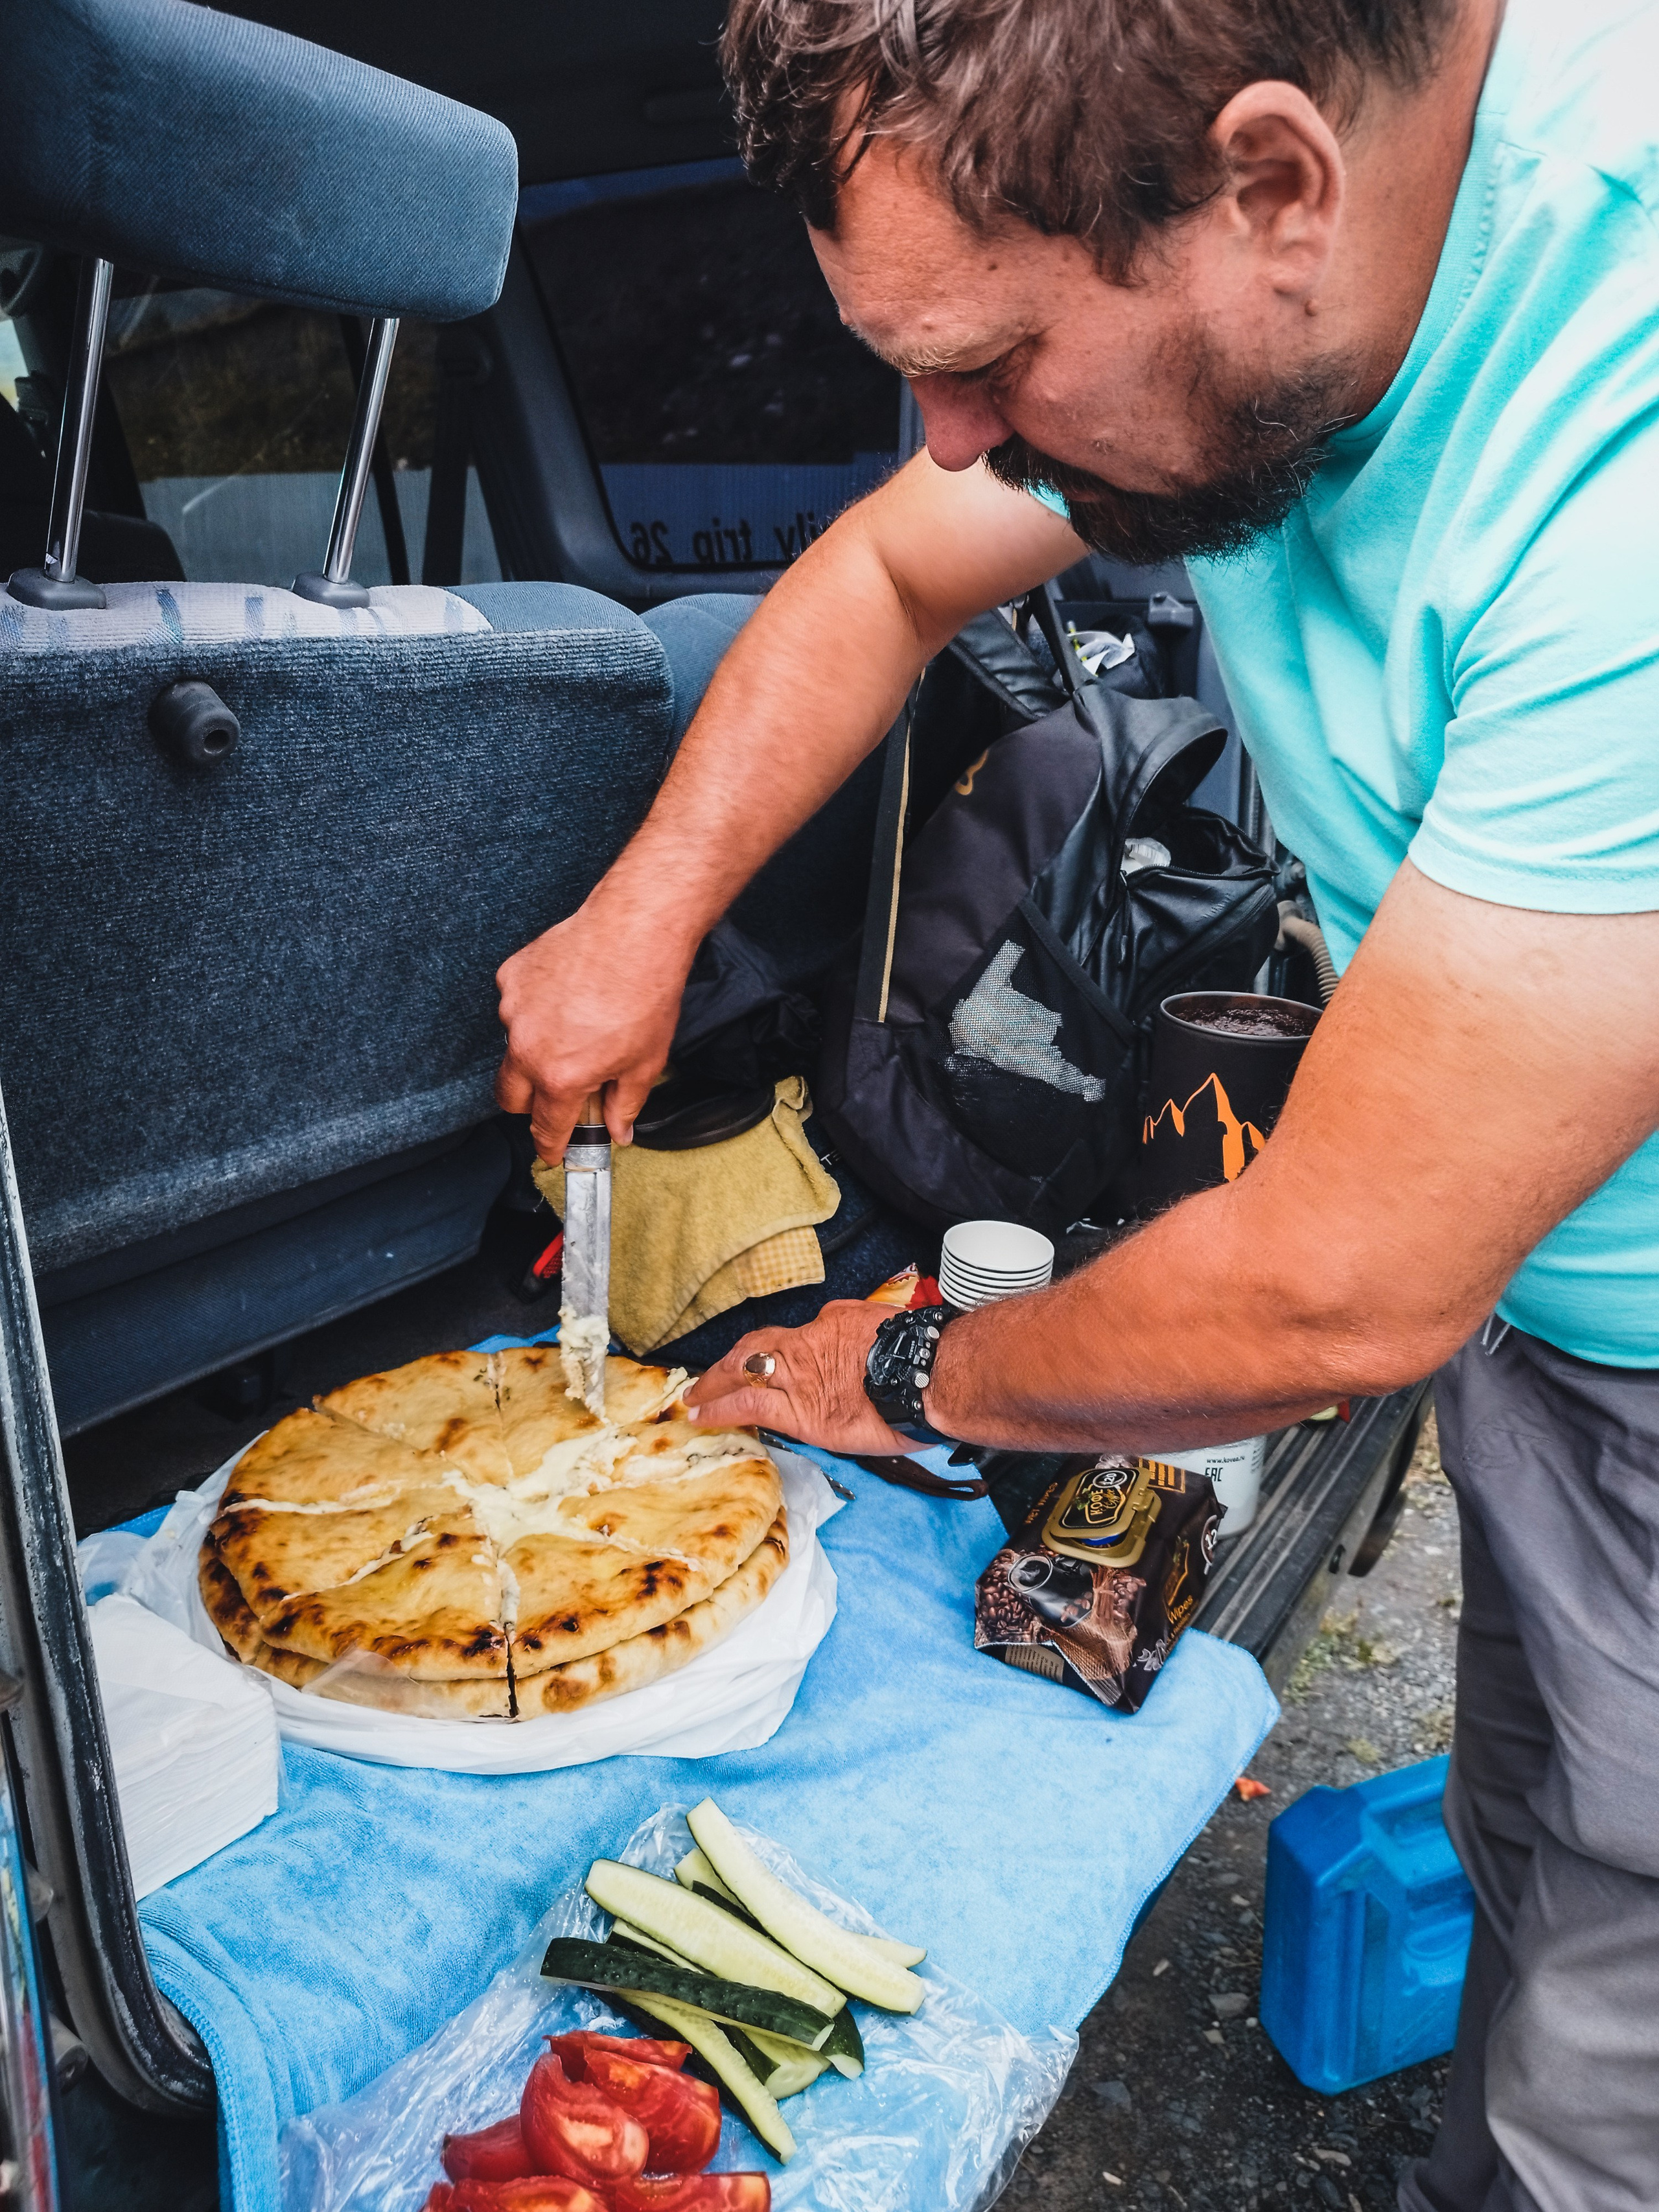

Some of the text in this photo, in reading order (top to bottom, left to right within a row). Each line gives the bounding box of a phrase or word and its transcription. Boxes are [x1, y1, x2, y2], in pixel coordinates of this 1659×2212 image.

[1102, 1473, 1117, 1485] 120
[1090, 1489, 1103, 1515] КОФЕ
[1205, 1529, 1217, 1550] 12
